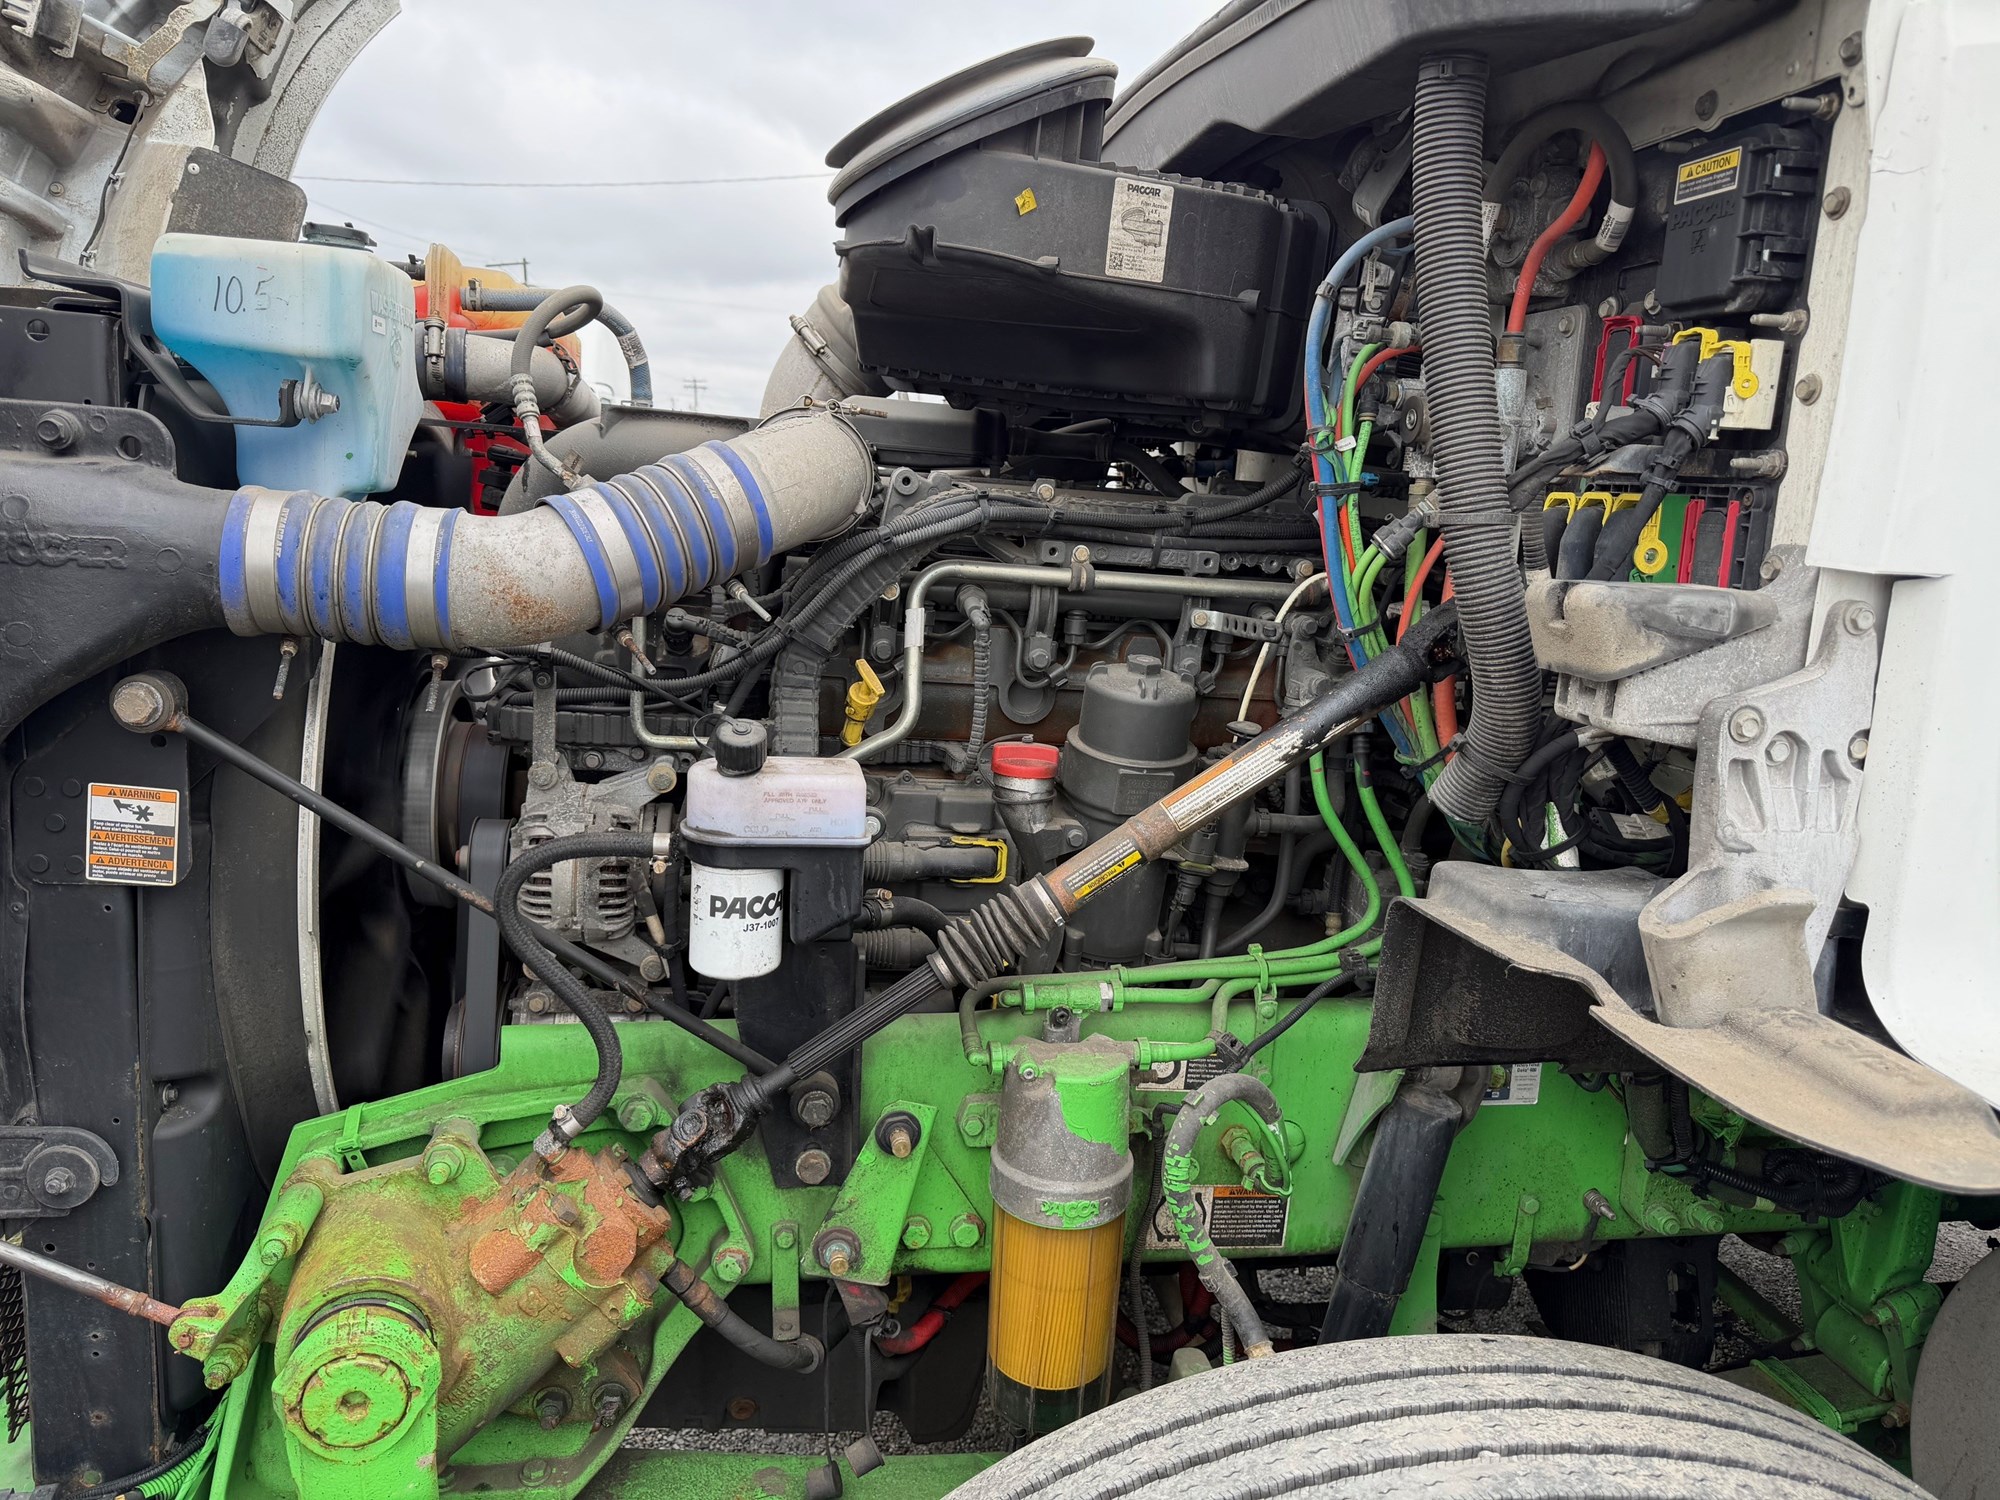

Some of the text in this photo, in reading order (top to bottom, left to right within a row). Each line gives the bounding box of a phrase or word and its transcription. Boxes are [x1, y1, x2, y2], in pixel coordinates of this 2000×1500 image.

[1695, 156, 1731, 175] CAUTION
[1127, 184, 1161, 197] PACCAR
[119, 789, 161, 800] WARNING
[104, 832, 173, 845] AVERTISSEMENT
[108, 857, 168, 869] ADVERTENCIA
[709, 889, 783, 919] PACCA
